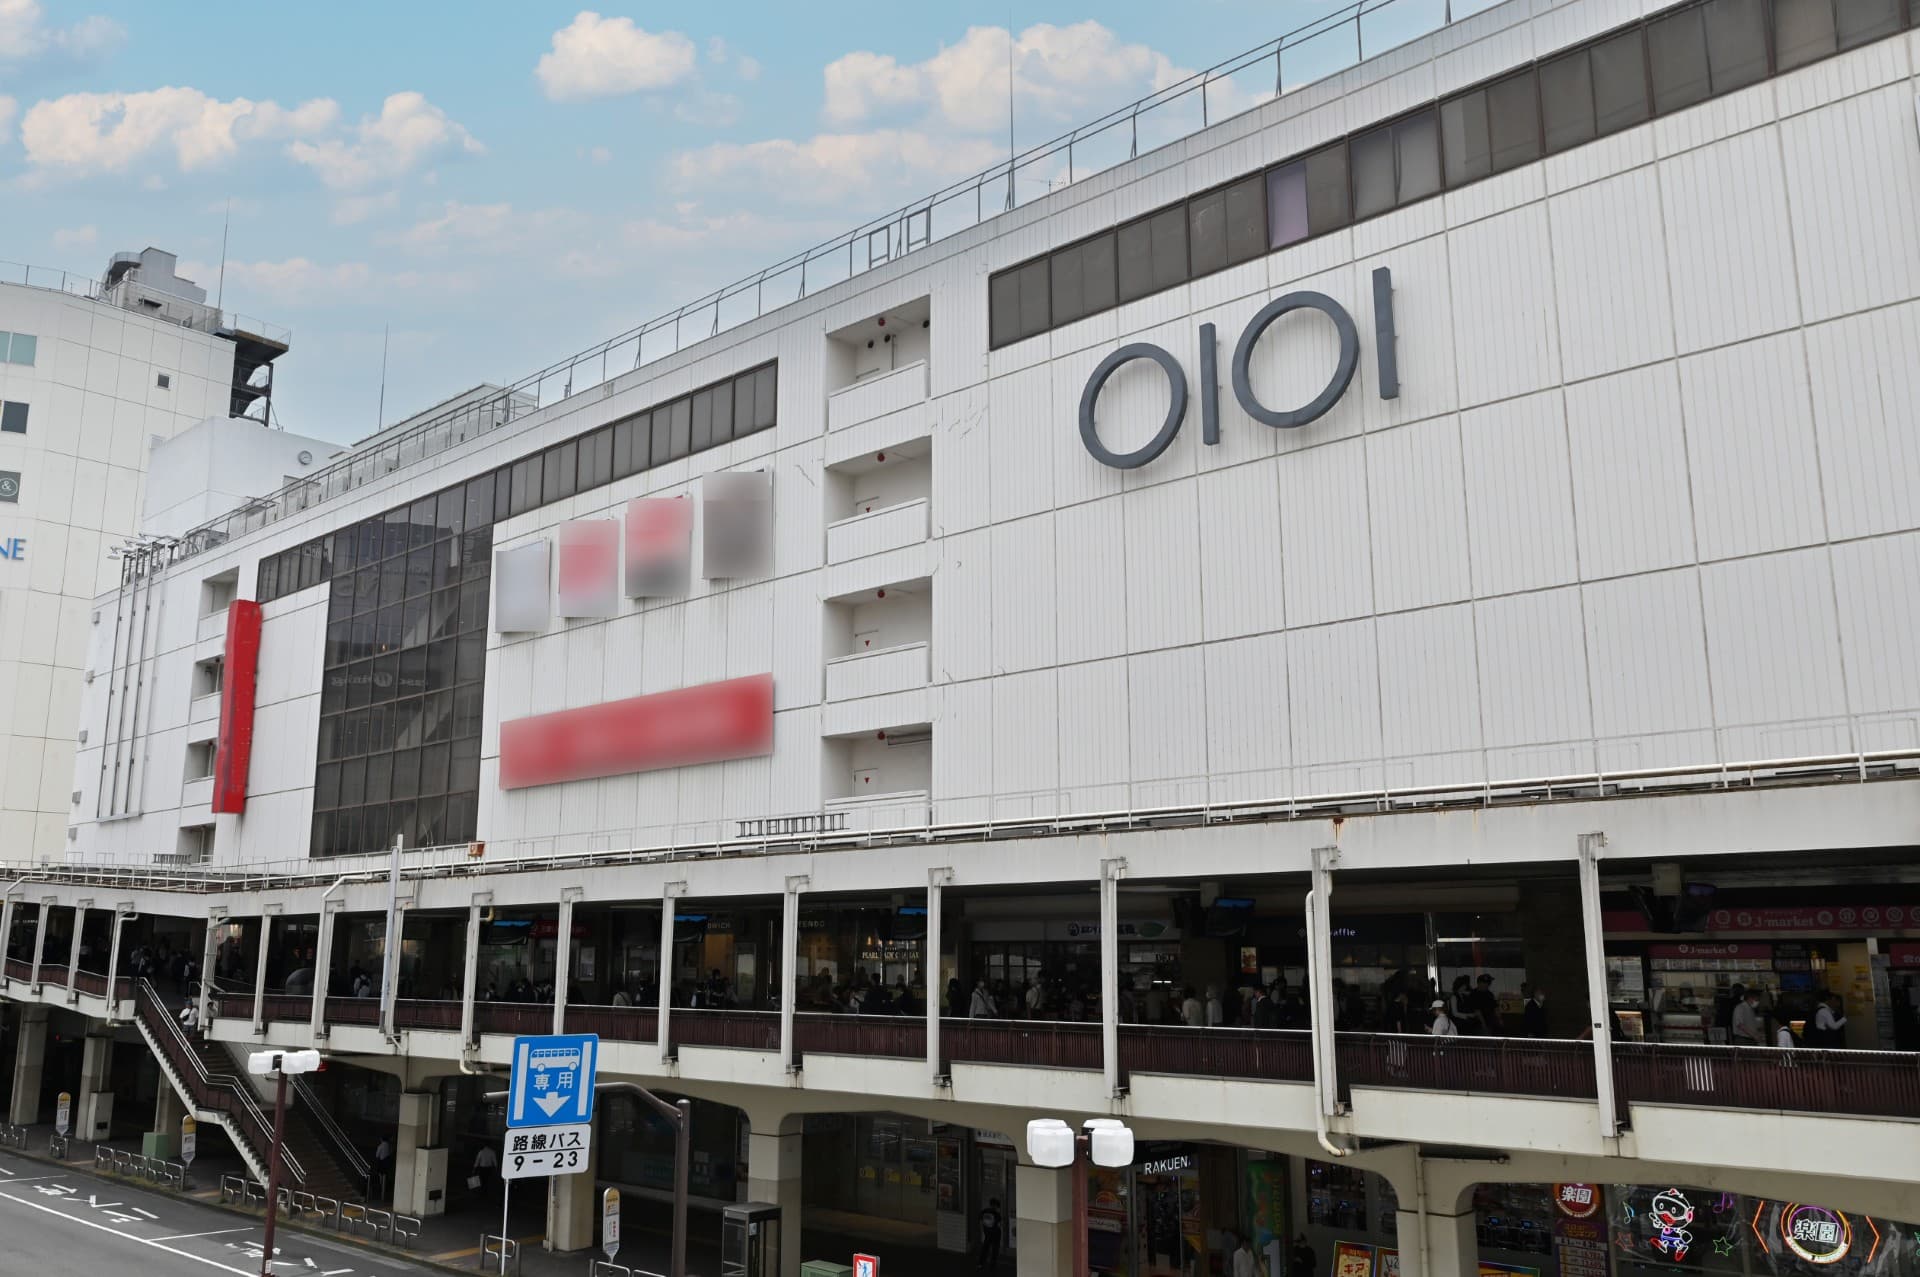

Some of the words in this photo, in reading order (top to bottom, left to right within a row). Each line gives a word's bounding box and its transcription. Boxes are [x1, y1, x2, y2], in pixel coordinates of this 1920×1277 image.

[533, 1072, 573, 1090] 専用
[513, 1132, 581, 1151] 路線バス
[1144, 1155, 1188, 1176] RAKUEN
[1561, 1186, 1592, 1204] 楽園
[1793, 1218, 1839, 1243] 楽園
